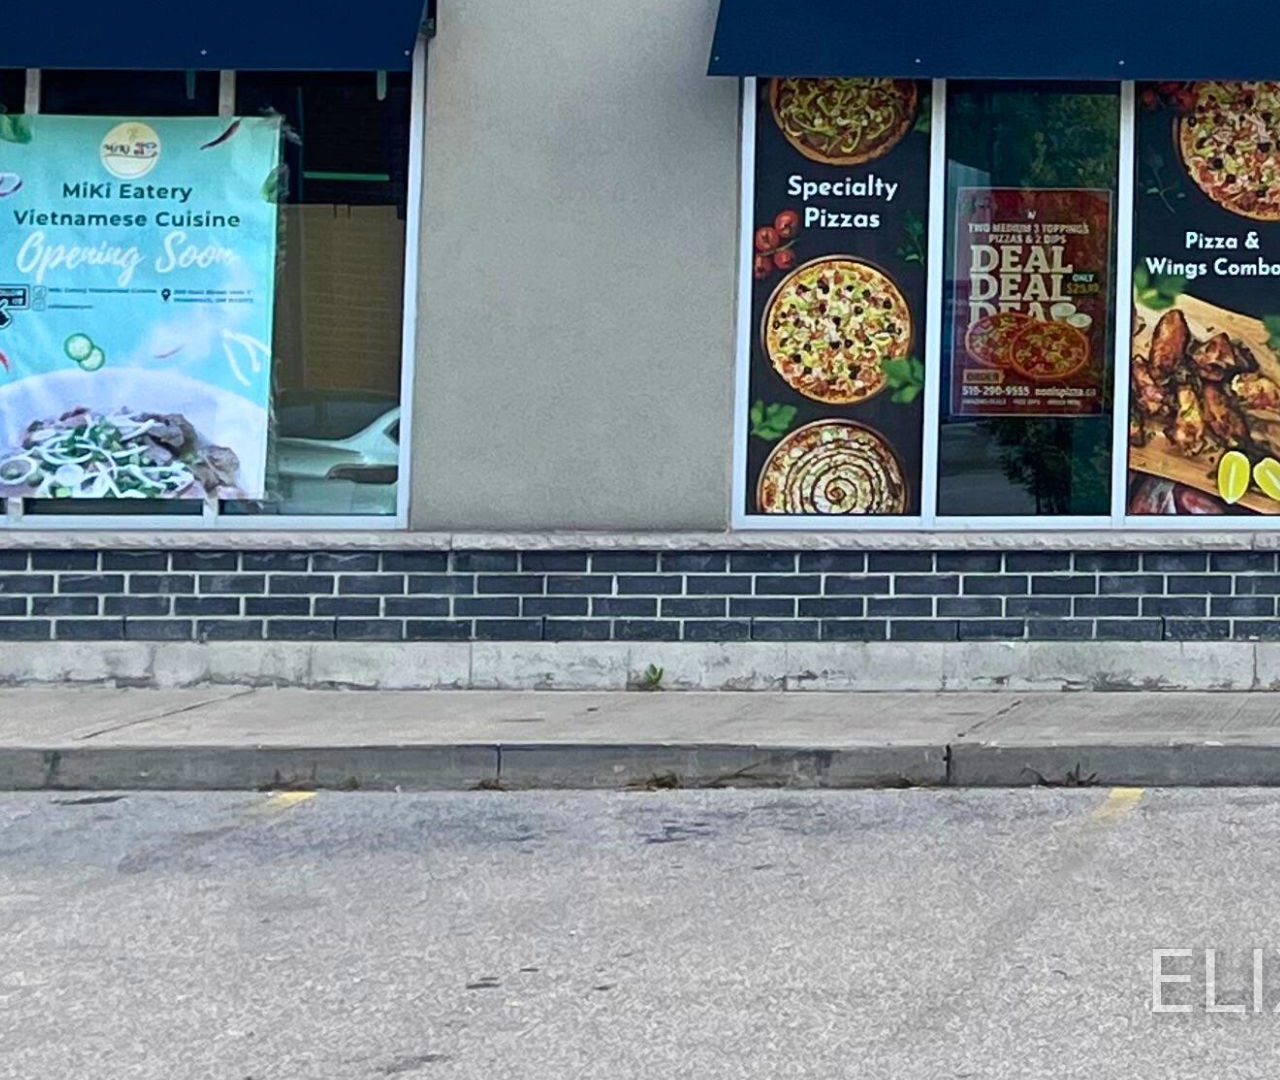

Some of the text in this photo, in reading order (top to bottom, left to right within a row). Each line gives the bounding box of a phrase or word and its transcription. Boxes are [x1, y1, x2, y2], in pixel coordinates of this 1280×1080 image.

[63, 182, 193, 203] MiKi Eatery
[787, 174, 898, 201] Specialty
[13, 208, 241, 228] Vietnamese Cuisine
[804, 206, 880, 228] Pizzas
[968, 222, 991, 233] TWO
[988, 234, 1023, 243] PIZZAS
[1035, 234, 1042, 244] 2
[1185, 231, 1260, 249] Pizza &
[16, 229, 241, 287] Opening Soon
[970, 244, 1073, 273] DEAL
[1145, 257, 1208, 280] Wings
[969, 273, 1072, 301] DEAL
[962, 385, 1031, 396] 519-290-9555
